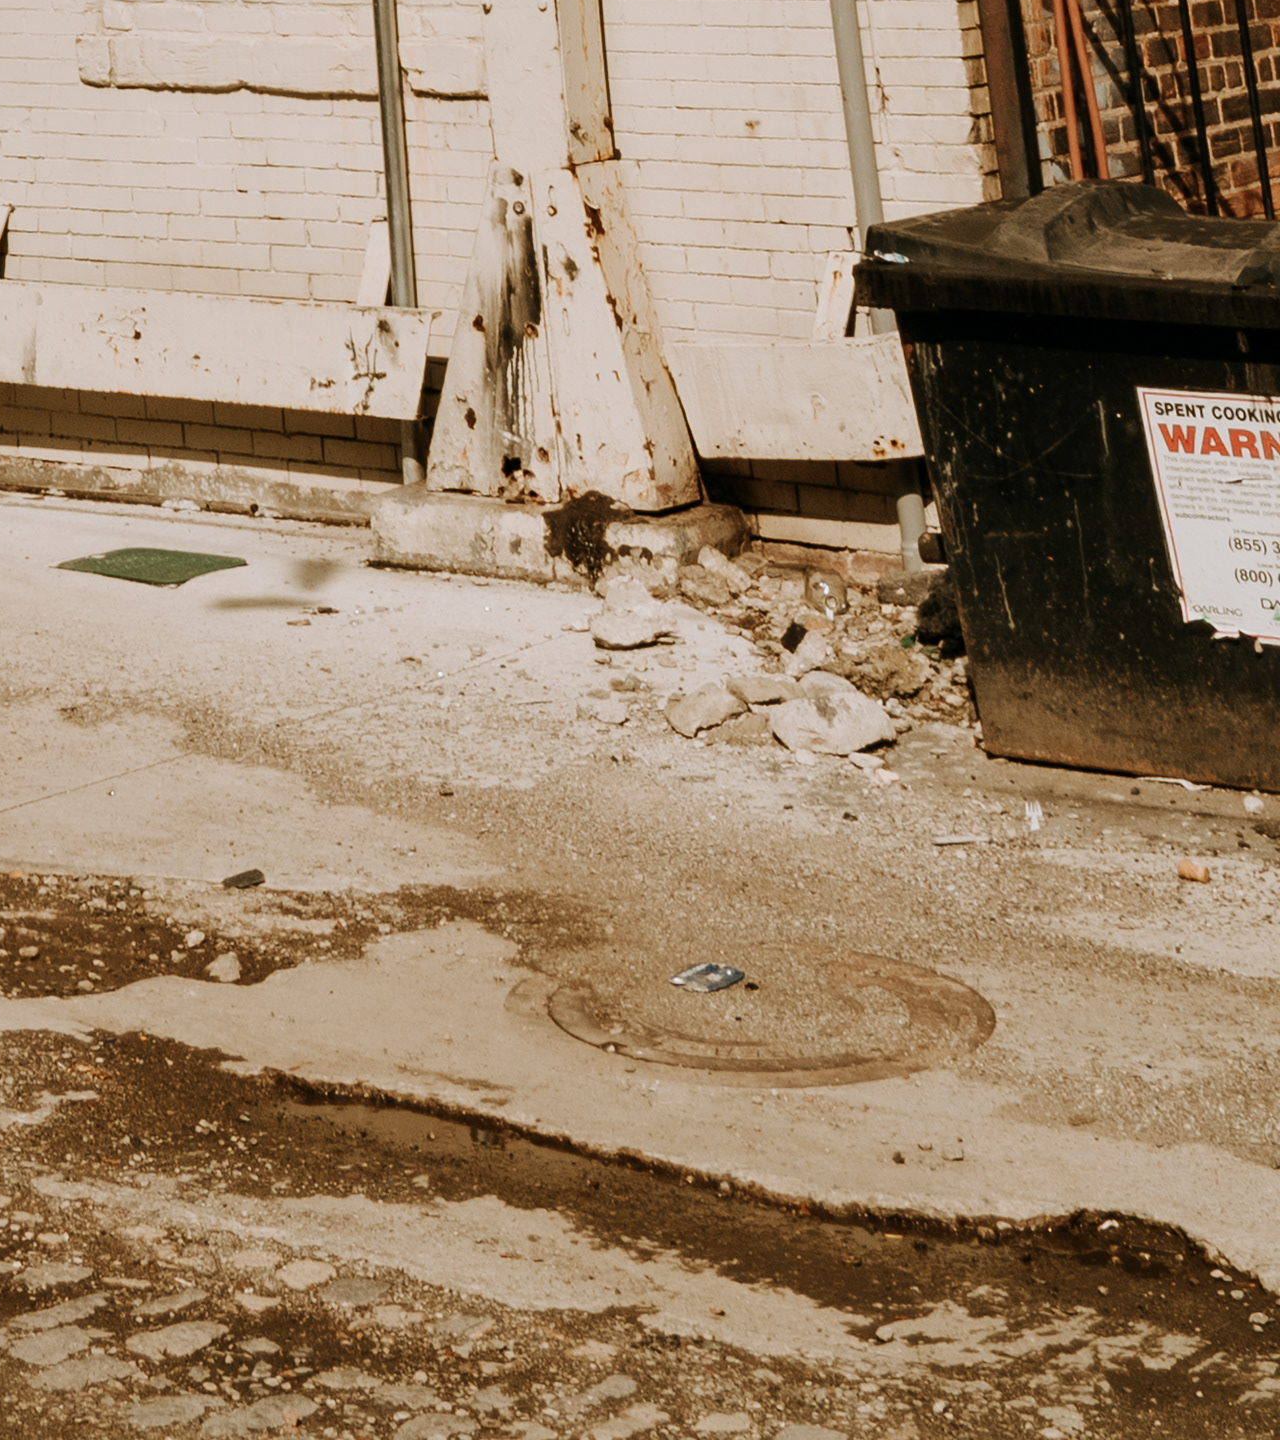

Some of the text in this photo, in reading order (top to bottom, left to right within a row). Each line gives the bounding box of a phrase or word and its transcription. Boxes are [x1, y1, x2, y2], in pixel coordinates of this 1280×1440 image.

[1154, 402, 1205, 418] SPENT
[1228, 537, 1268, 556] (855)
[1235, 568, 1273, 588] (800)
[1193, 604, 1244, 617] DARLING
